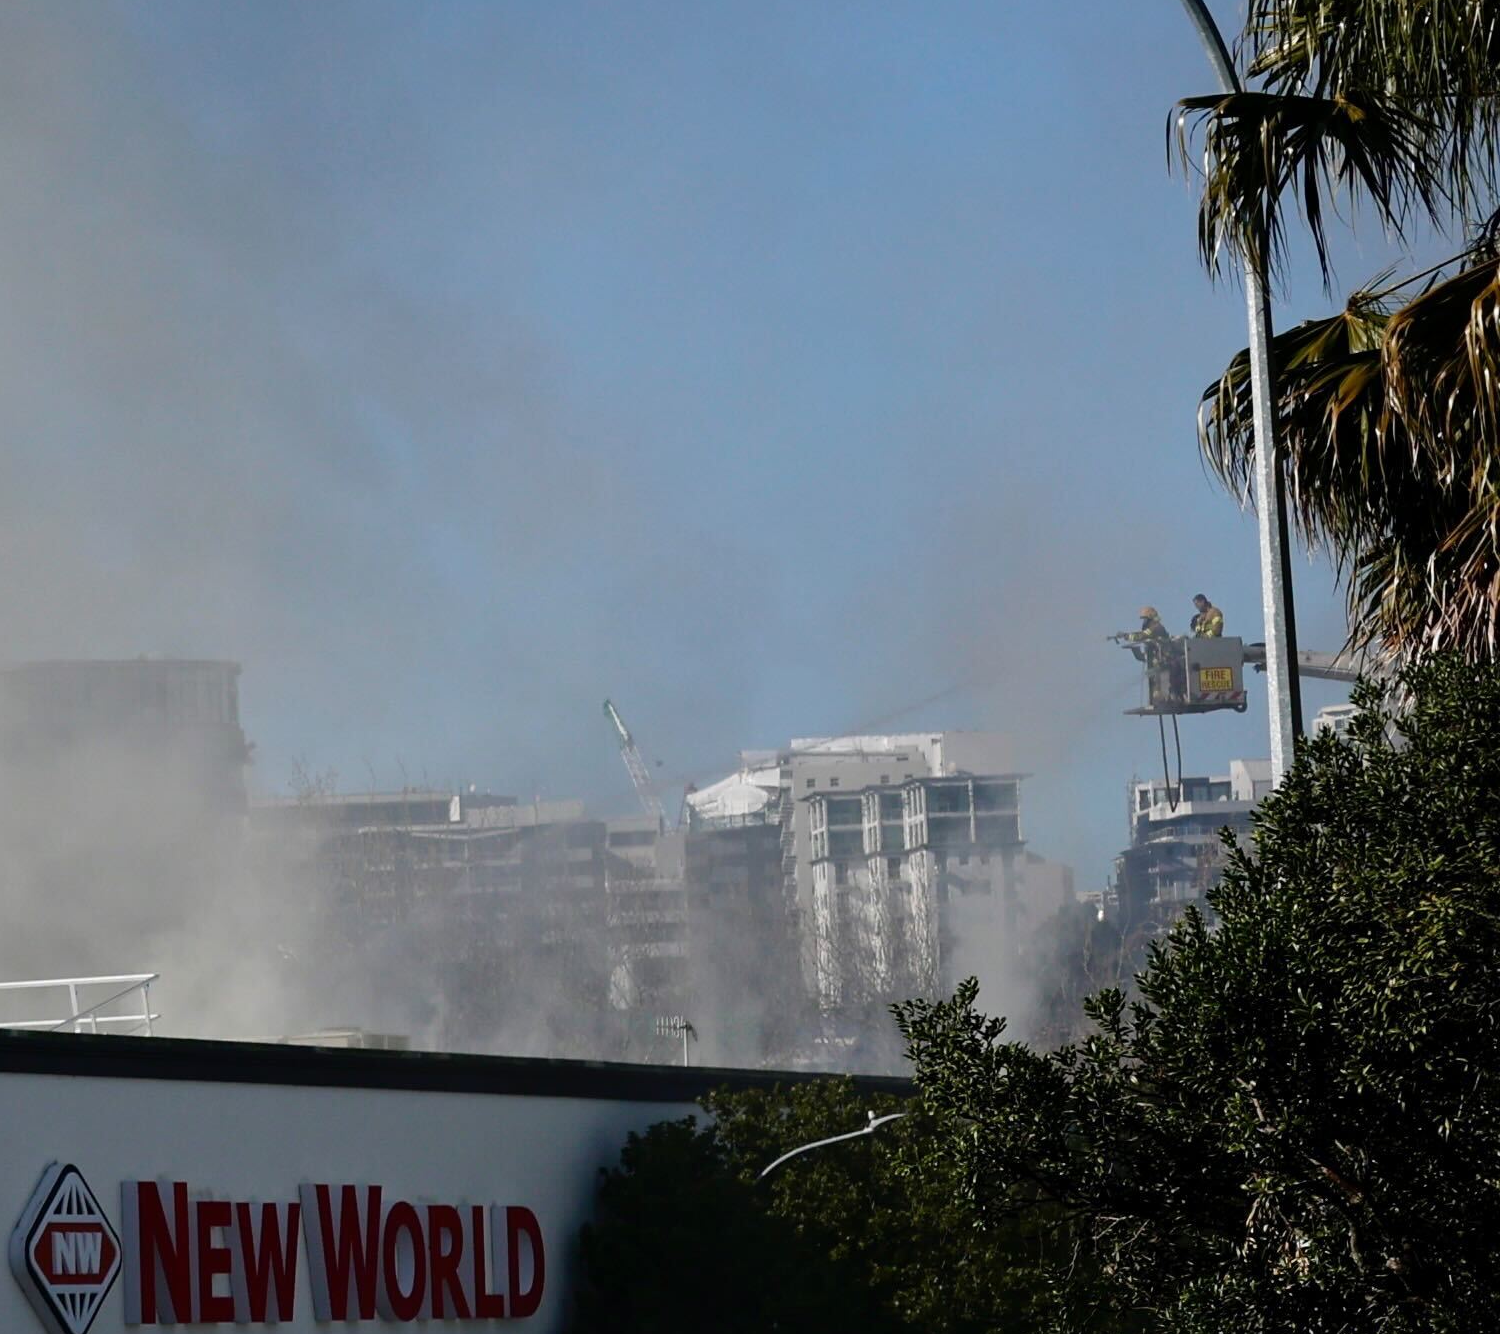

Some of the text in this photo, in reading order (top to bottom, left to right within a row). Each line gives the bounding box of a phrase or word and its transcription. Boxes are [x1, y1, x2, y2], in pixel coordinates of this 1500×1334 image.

[52, 1231, 101, 1275] NW
[138, 1181, 545, 1324] NEW WORLD
